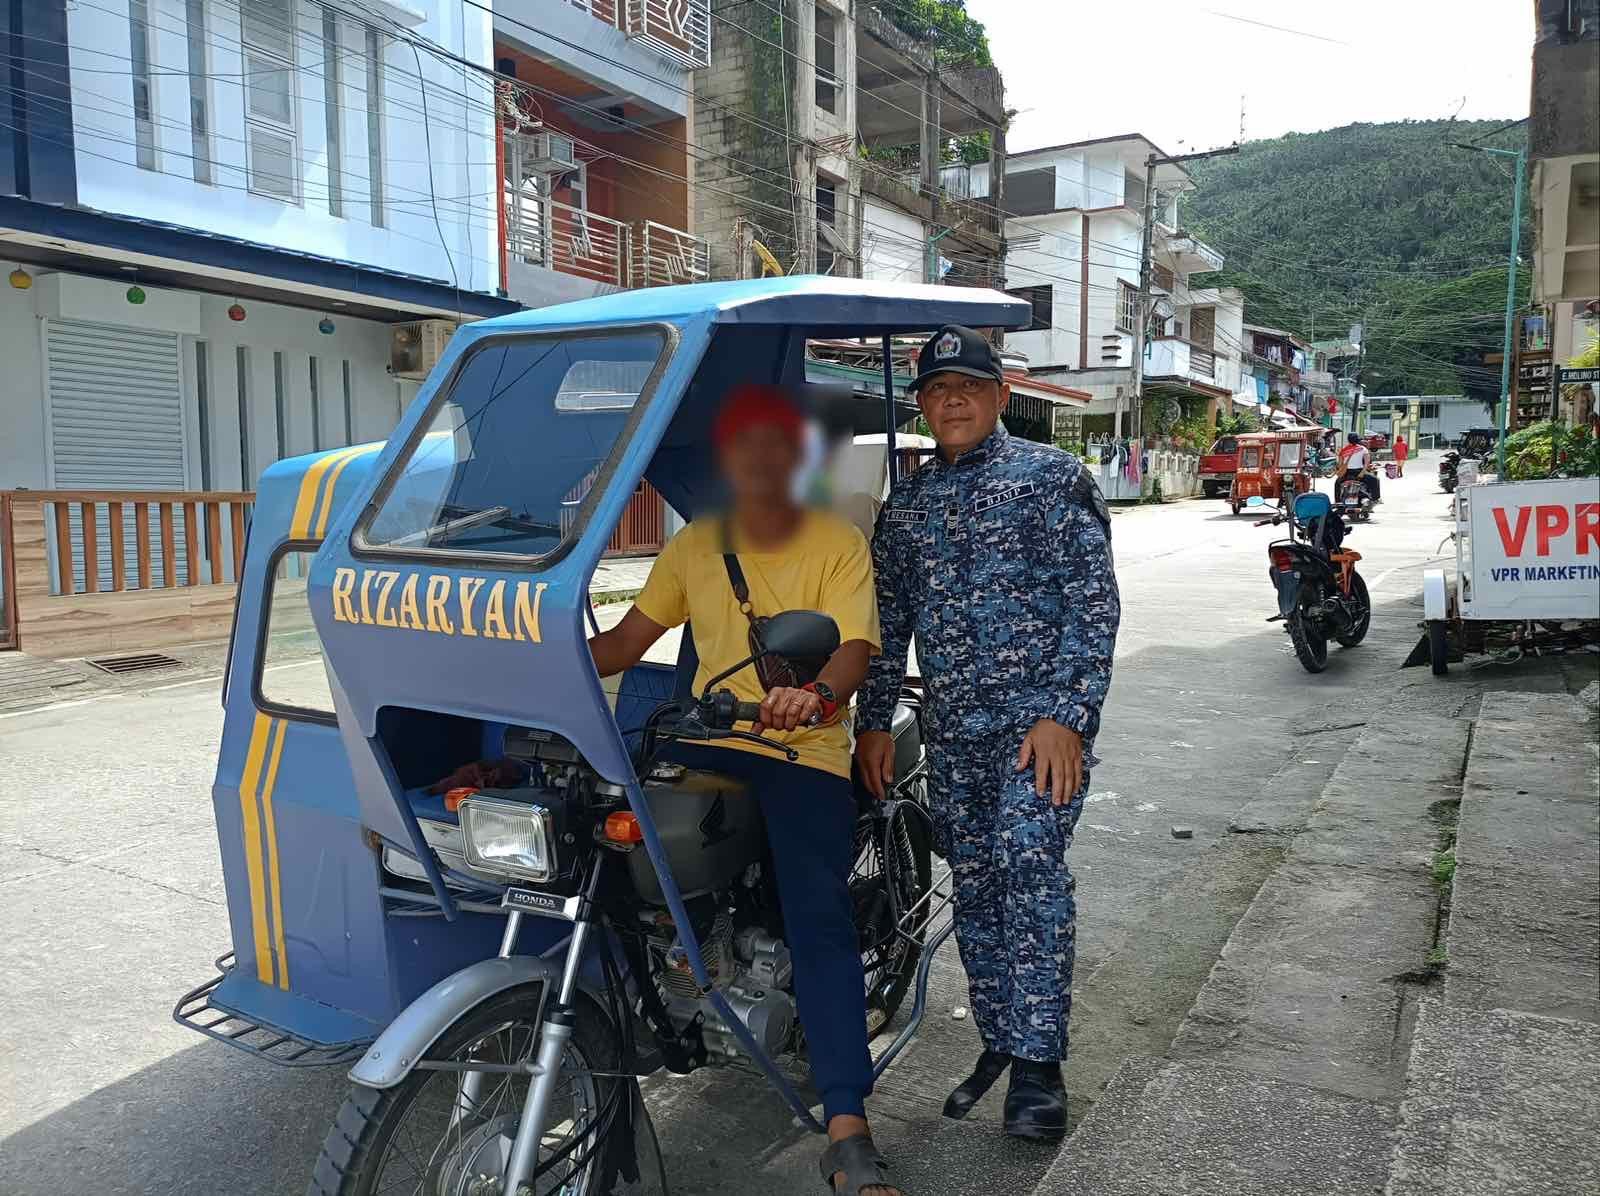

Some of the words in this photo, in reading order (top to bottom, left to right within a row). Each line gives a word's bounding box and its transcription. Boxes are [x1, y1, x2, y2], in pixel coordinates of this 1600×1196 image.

[986, 488, 1021, 506] BJMP
[1491, 504, 1600, 558] VPR
[1491, 567, 1520, 581] VPR
[332, 567, 548, 643] RIZARYAN
[513, 893, 556, 908] HONDA
